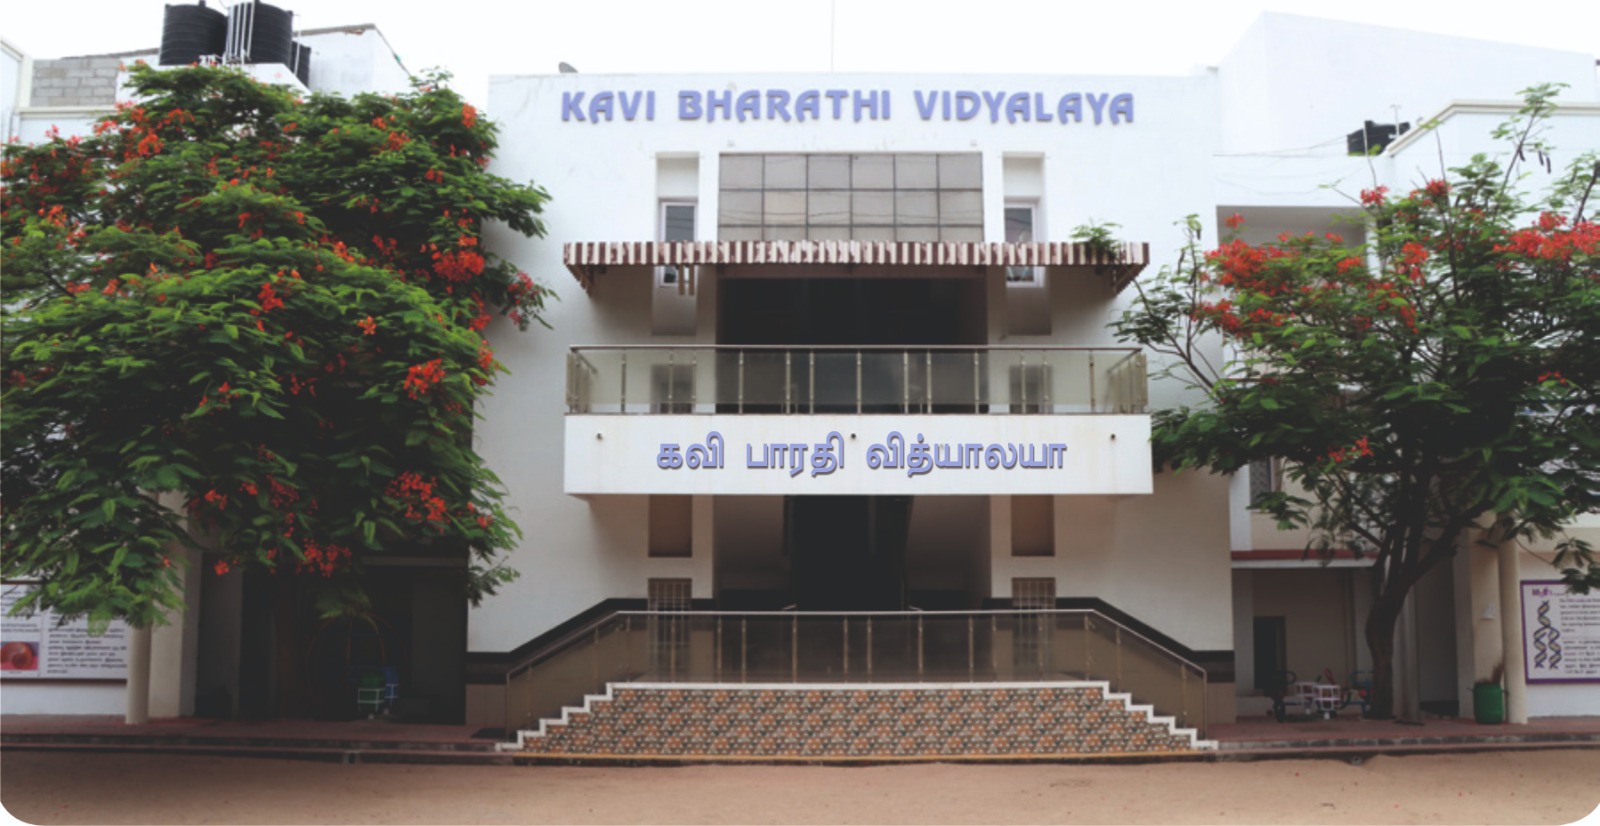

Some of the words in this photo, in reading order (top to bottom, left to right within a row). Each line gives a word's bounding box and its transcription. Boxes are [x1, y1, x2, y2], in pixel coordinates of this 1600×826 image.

[561, 90, 656, 123] KAVI
[677, 89, 892, 122] BHARATHI
[913, 90, 1135, 125] VIDYALAYA
[655, 431, 725, 469] கவி
[745, 431, 845, 477] பாரதி
[865, 431, 1067, 477] வித்யாலயா
